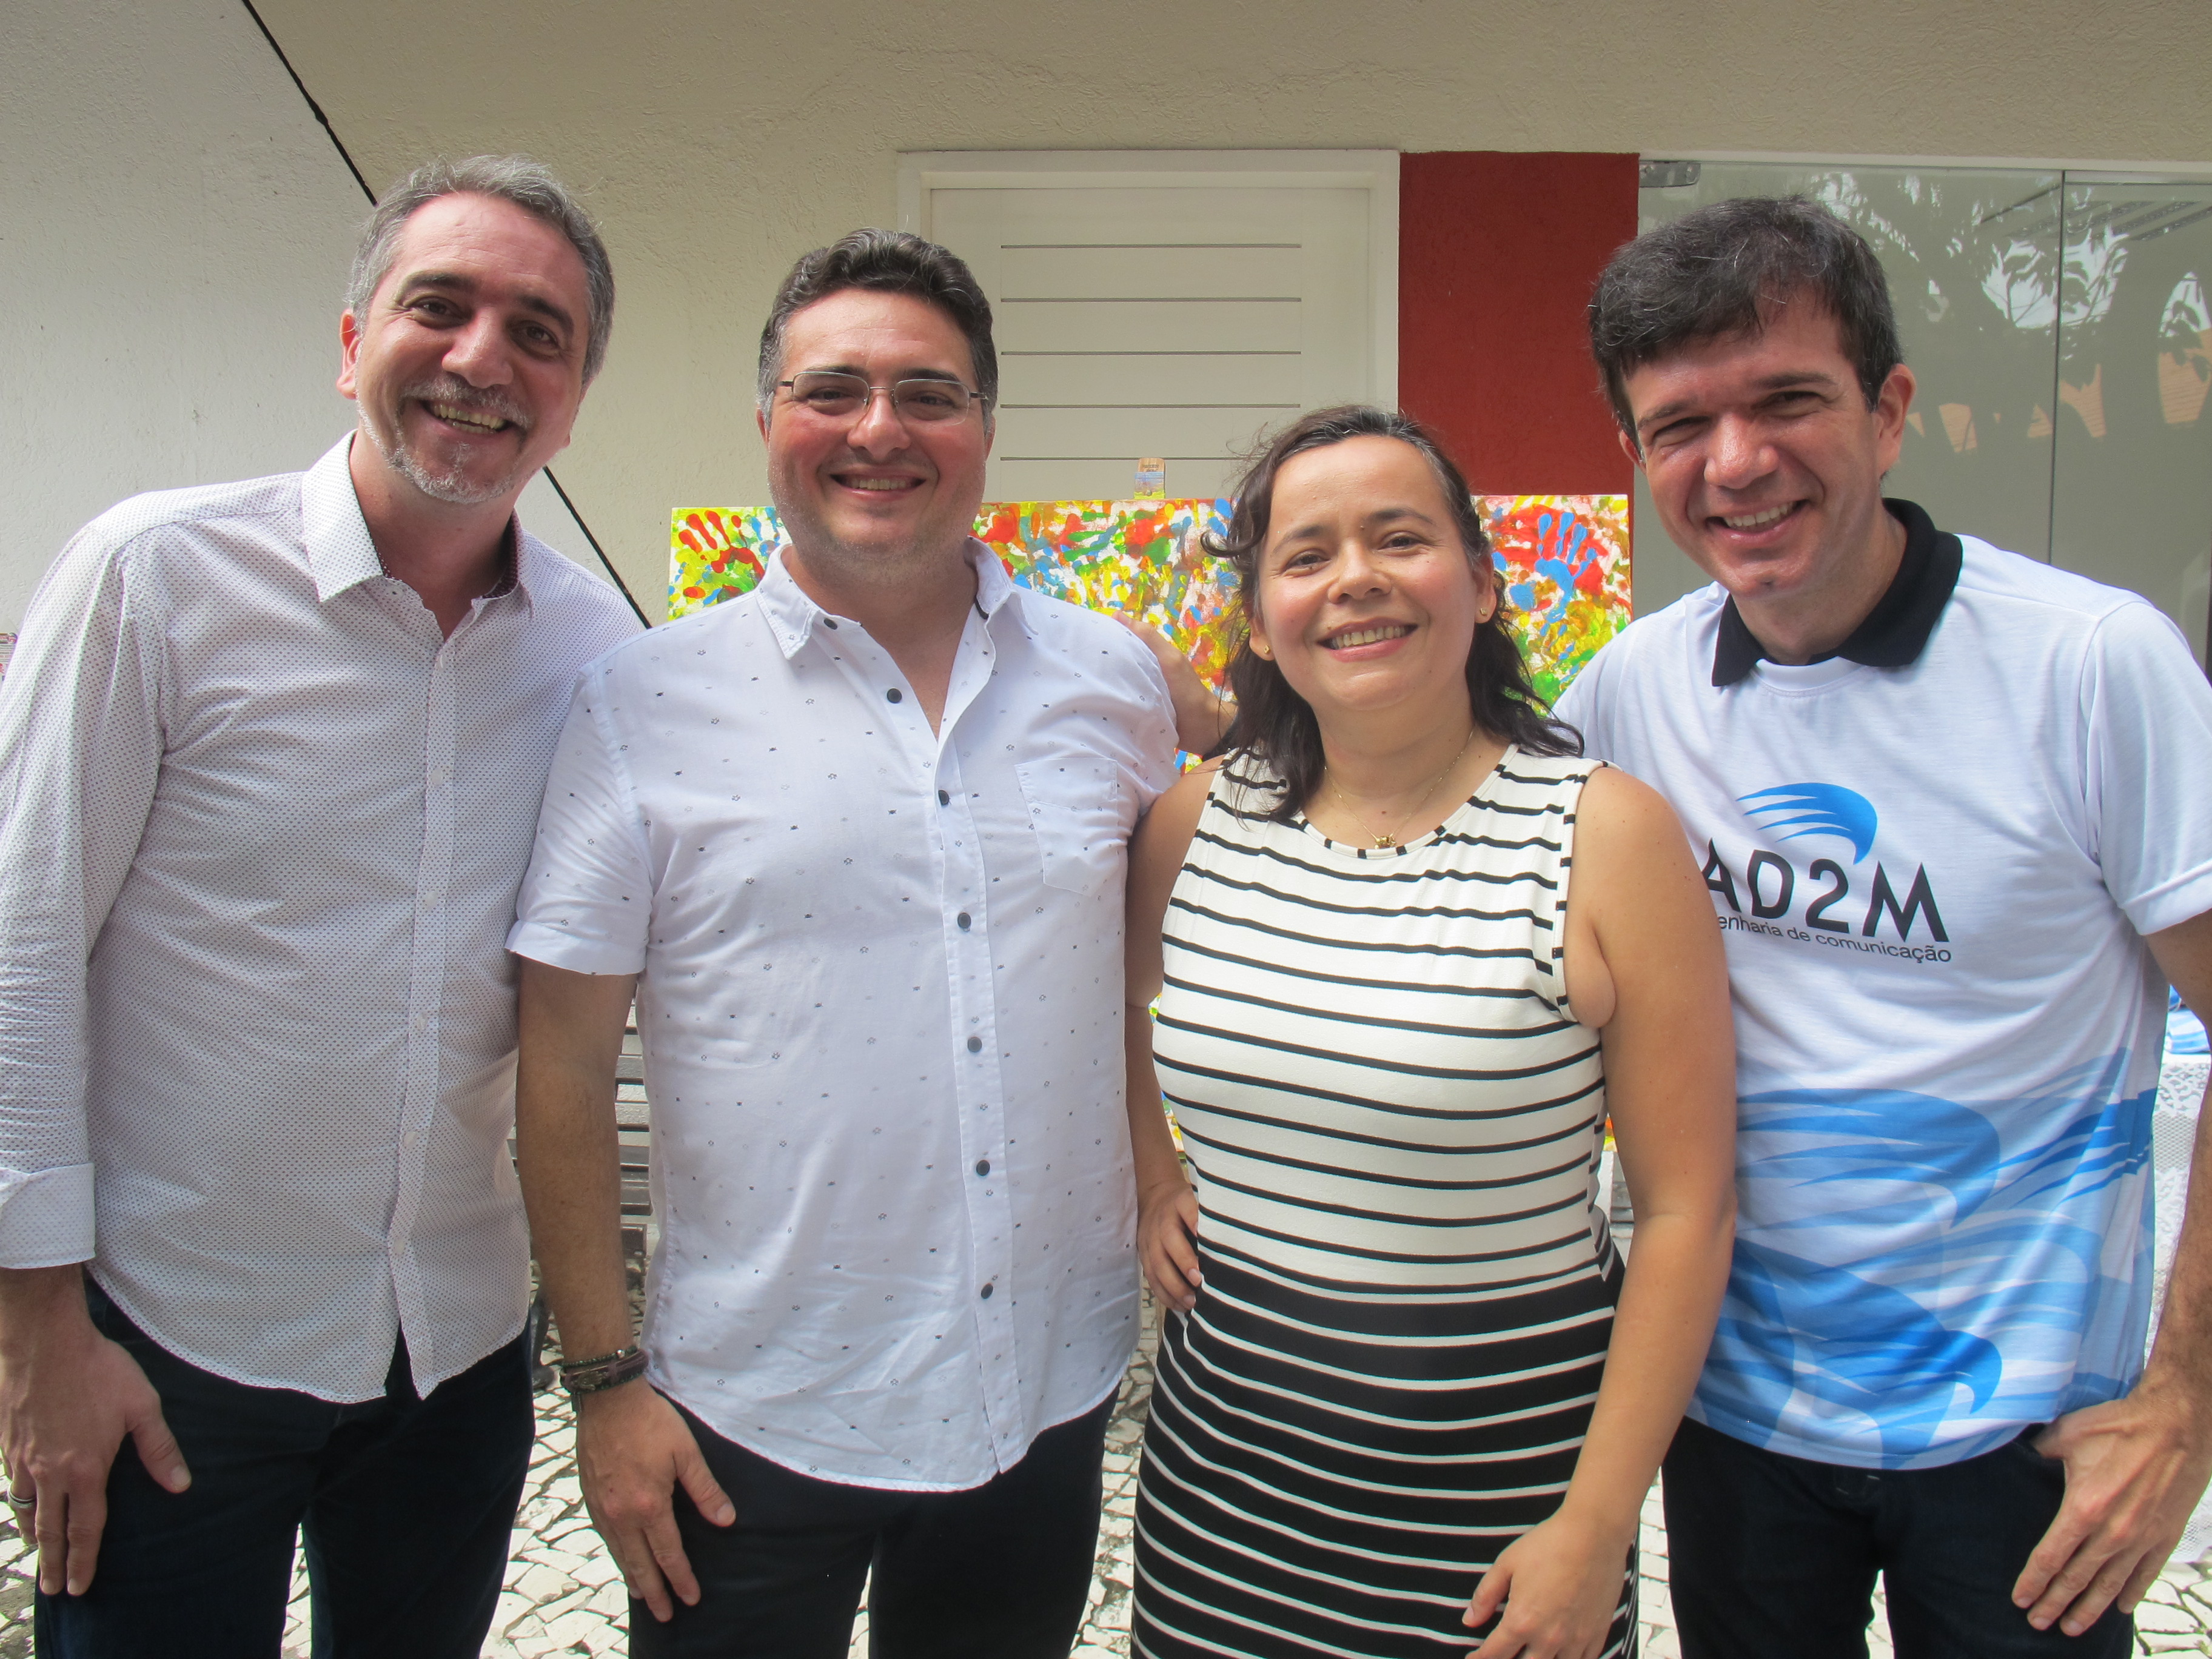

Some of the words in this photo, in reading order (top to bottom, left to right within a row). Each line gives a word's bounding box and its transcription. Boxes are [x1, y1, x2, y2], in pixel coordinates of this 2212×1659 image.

[1702, 837, 1950, 943] AD2M
[1718, 915, 1784, 937] enharia
[1787, 927, 1811, 942] de
[1815, 934, 1952, 964] comunicação
